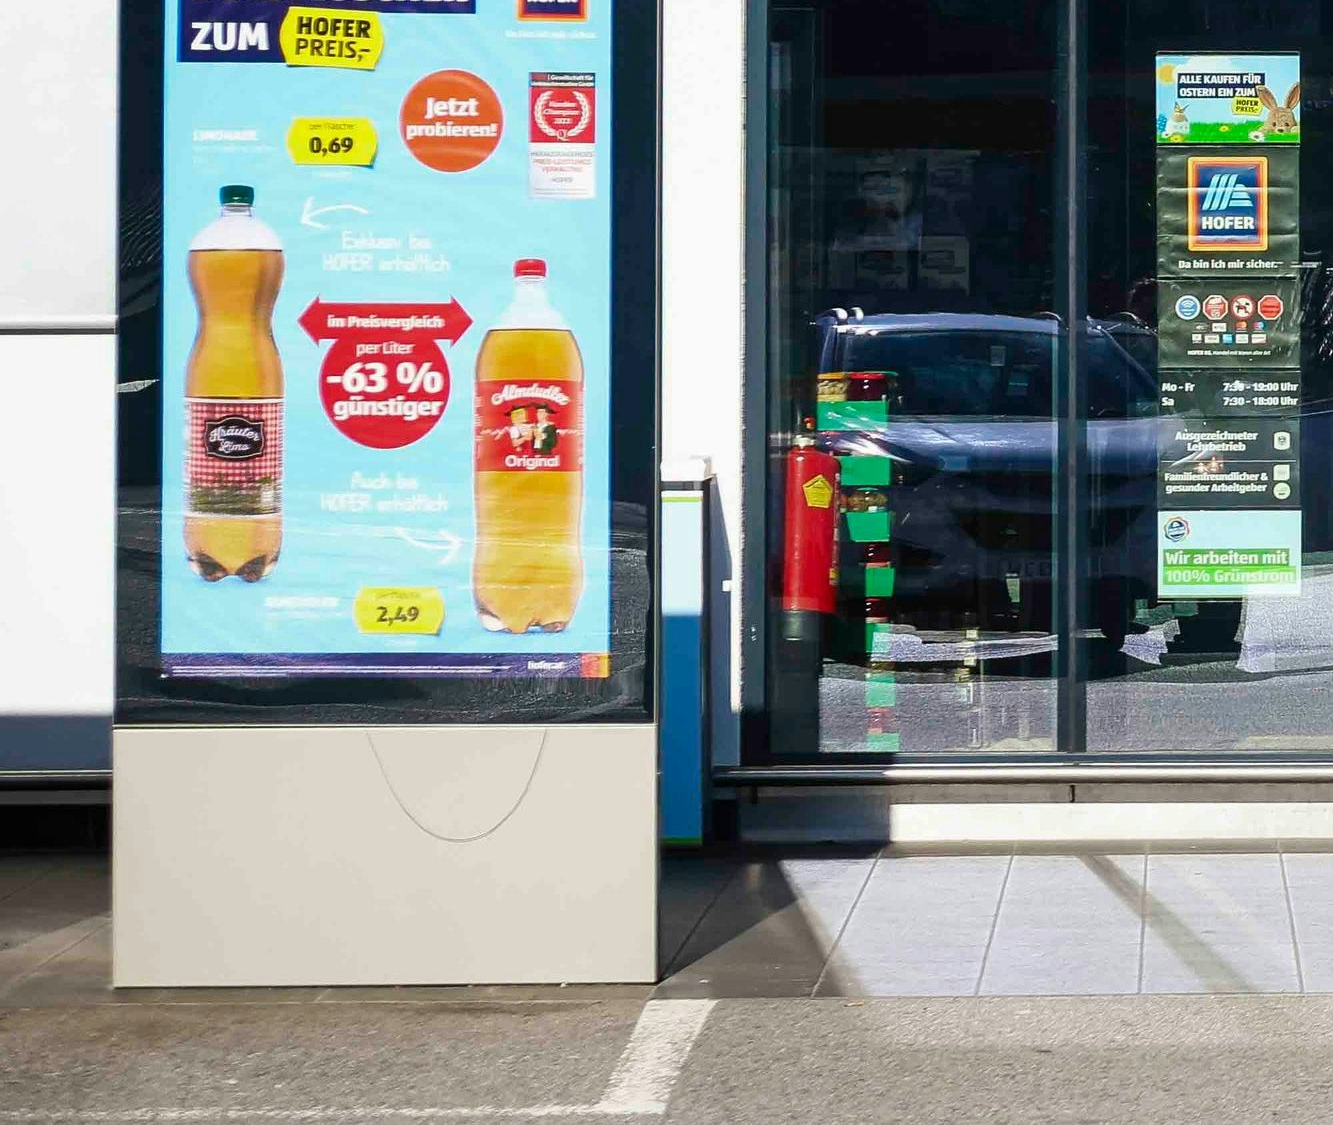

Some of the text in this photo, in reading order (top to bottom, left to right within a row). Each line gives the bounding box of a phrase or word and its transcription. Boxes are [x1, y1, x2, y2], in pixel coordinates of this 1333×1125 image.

[296, 16, 371, 39] HOFER
[190, 21, 270, 52] ZUM
[295, 37, 371, 61] PREIS,-
[1179, 72, 1262, 85] ALLE KAUFEN FÜR
[1179, 88, 1256, 98] OSTERN EIN ZUM
[425, 96, 479, 118] Jetzt
[1236, 98, 1259, 107] HOFER
[406, 121, 498, 141] probieren!
[308, 136, 354, 156] 0,69
[1201, 216, 1256, 231] HOFER
[1178, 259, 1278, 270] Da bin ich mir sicher.
[328, 313, 445, 331] im Preisvergleich
[356, 341, 414, 357] per Liter
[327, 363, 443, 394] -63 %
[1161, 383, 1177, 392] Mo
[1184, 383, 1195, 392] Fr
[1280, 383, 1299, 392] Uhr
[333, 395, 441, 422] günstiger
[1161, 397, 1174, 406] Sa
[1223, 397, 1245, 406] 7:30
[1280, 397, 1299, 406] Uhr
[1175, 430, 1258, 442] Ausgezeichneter
[1187, 442, 1246, 452] Lehrbetrieb
[504, 453, 560, 469] Original
[1164, 472, 1268, 482] Familienfreundlicher &
[1165, 482, 1268, 494] gesunder Arbeitgeber
[1165, 550, 1289, 565] Wir arbeiten mit
[1166, 568, 1295, 583] 100% Grünstrom
[376, 605, 420, 625] 2,49
